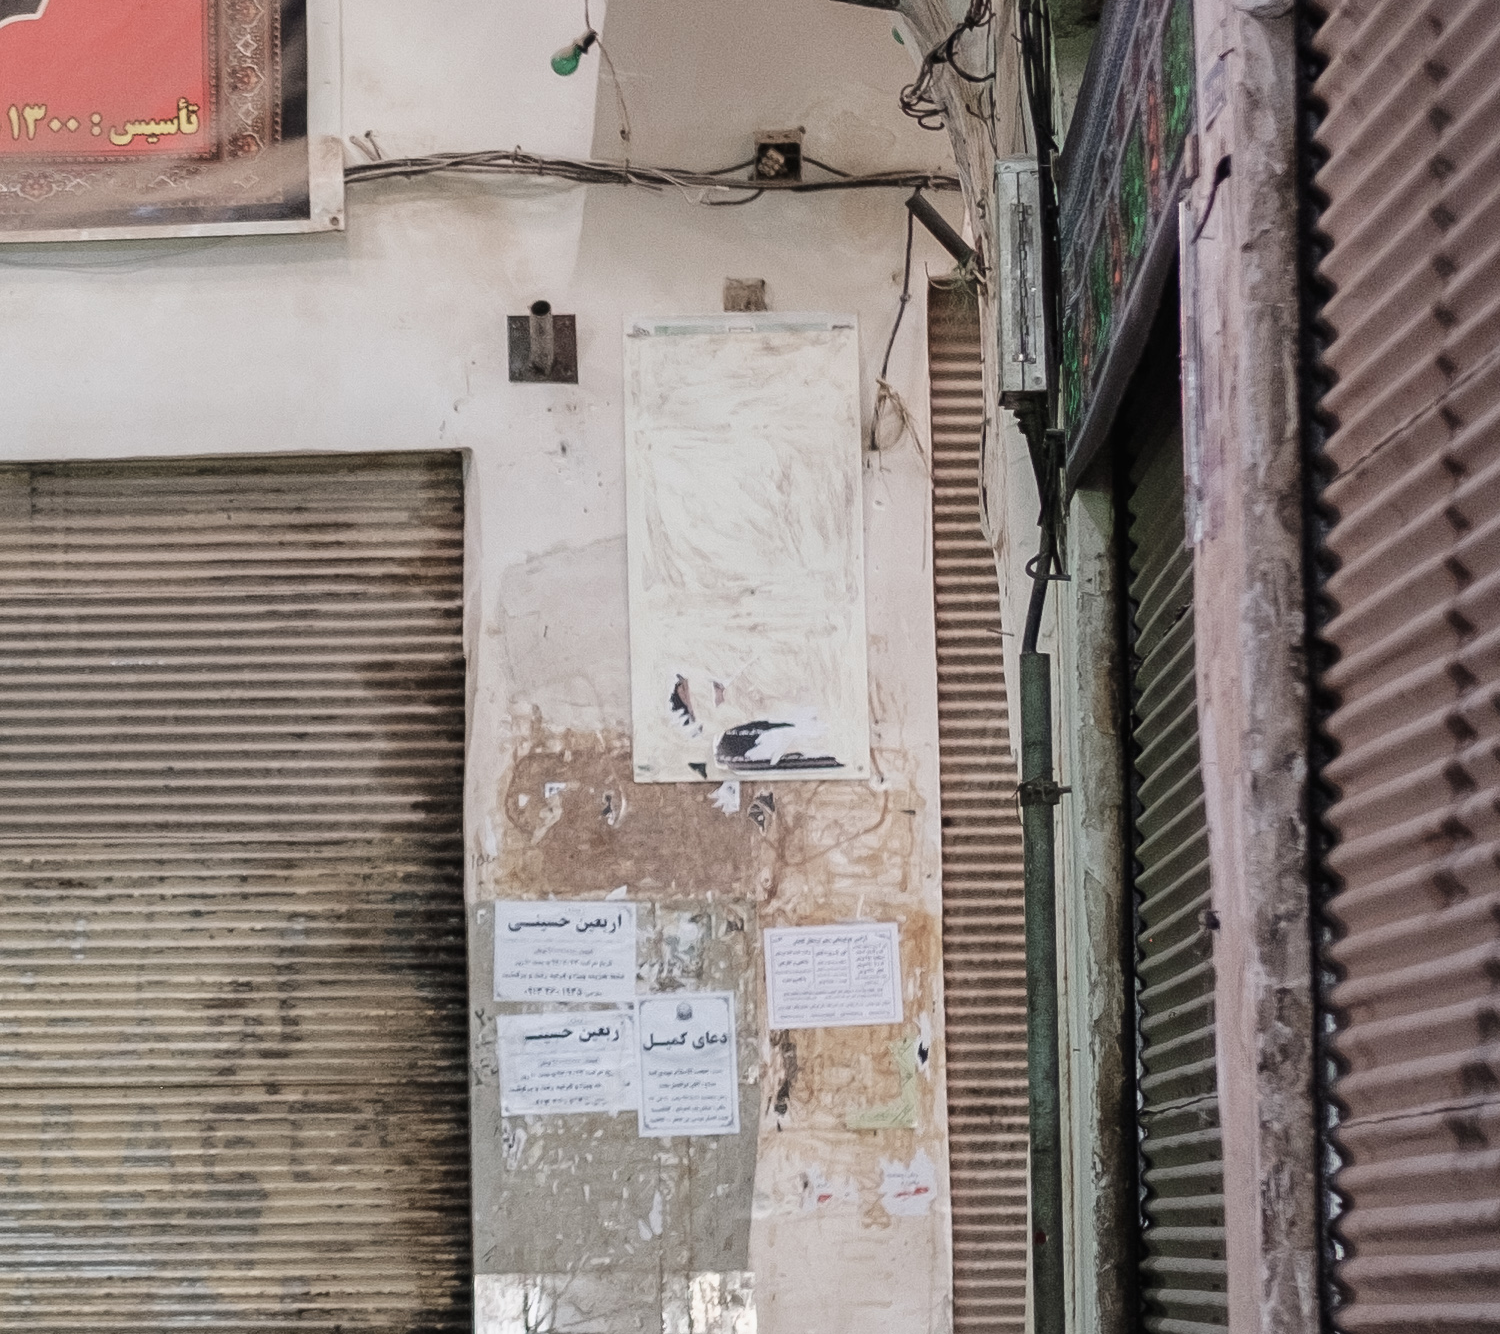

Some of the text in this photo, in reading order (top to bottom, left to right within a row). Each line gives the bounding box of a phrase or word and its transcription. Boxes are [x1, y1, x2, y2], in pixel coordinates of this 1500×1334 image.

[7, 103, 81, 141] ۱۳۰۰
[508, 913, 622, 934] اربعین حسینی
[642, 1030, 729, 1051] دعای کمیل
